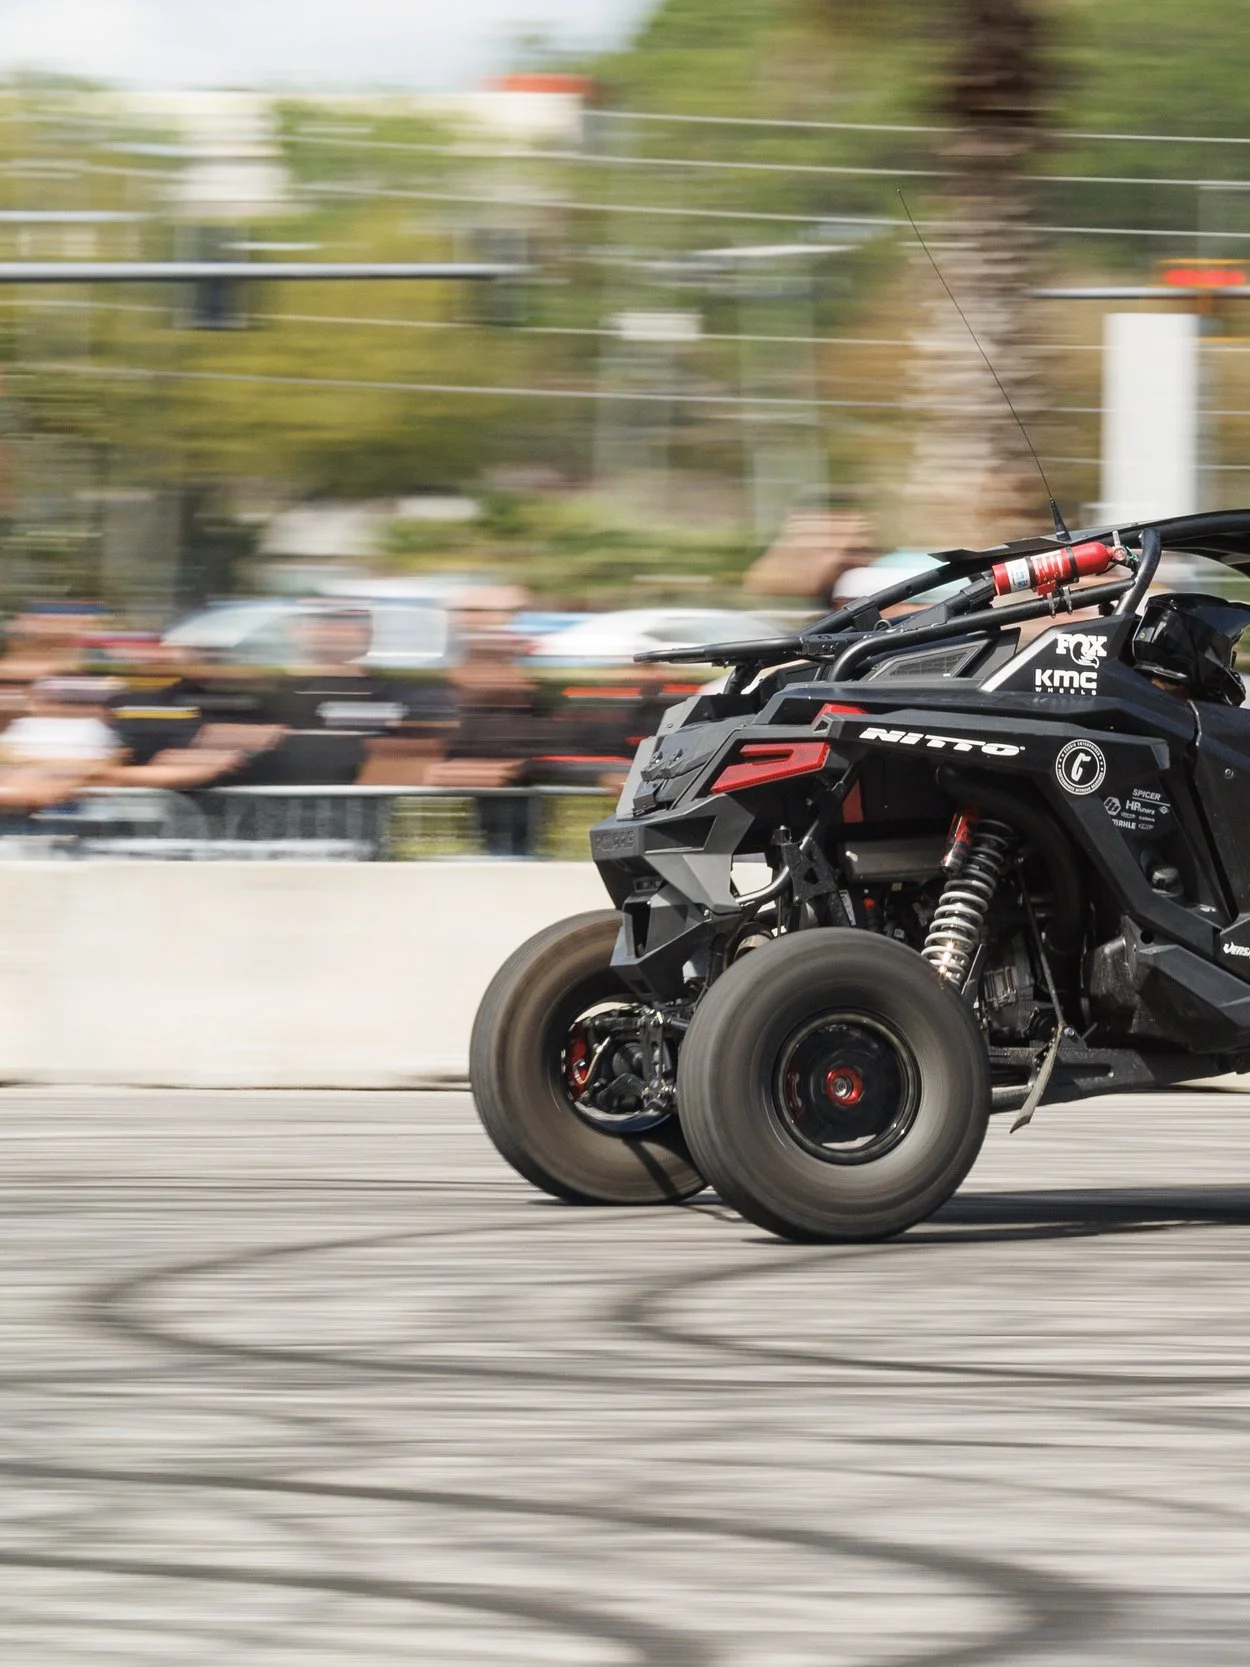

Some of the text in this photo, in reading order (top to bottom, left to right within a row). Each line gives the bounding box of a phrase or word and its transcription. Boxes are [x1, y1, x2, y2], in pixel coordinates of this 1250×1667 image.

[1055, 633, 1107, 669] FOX
[859, 727, 1020, 756] NITTO
[1132, 788, 1161, 801] SPICER
